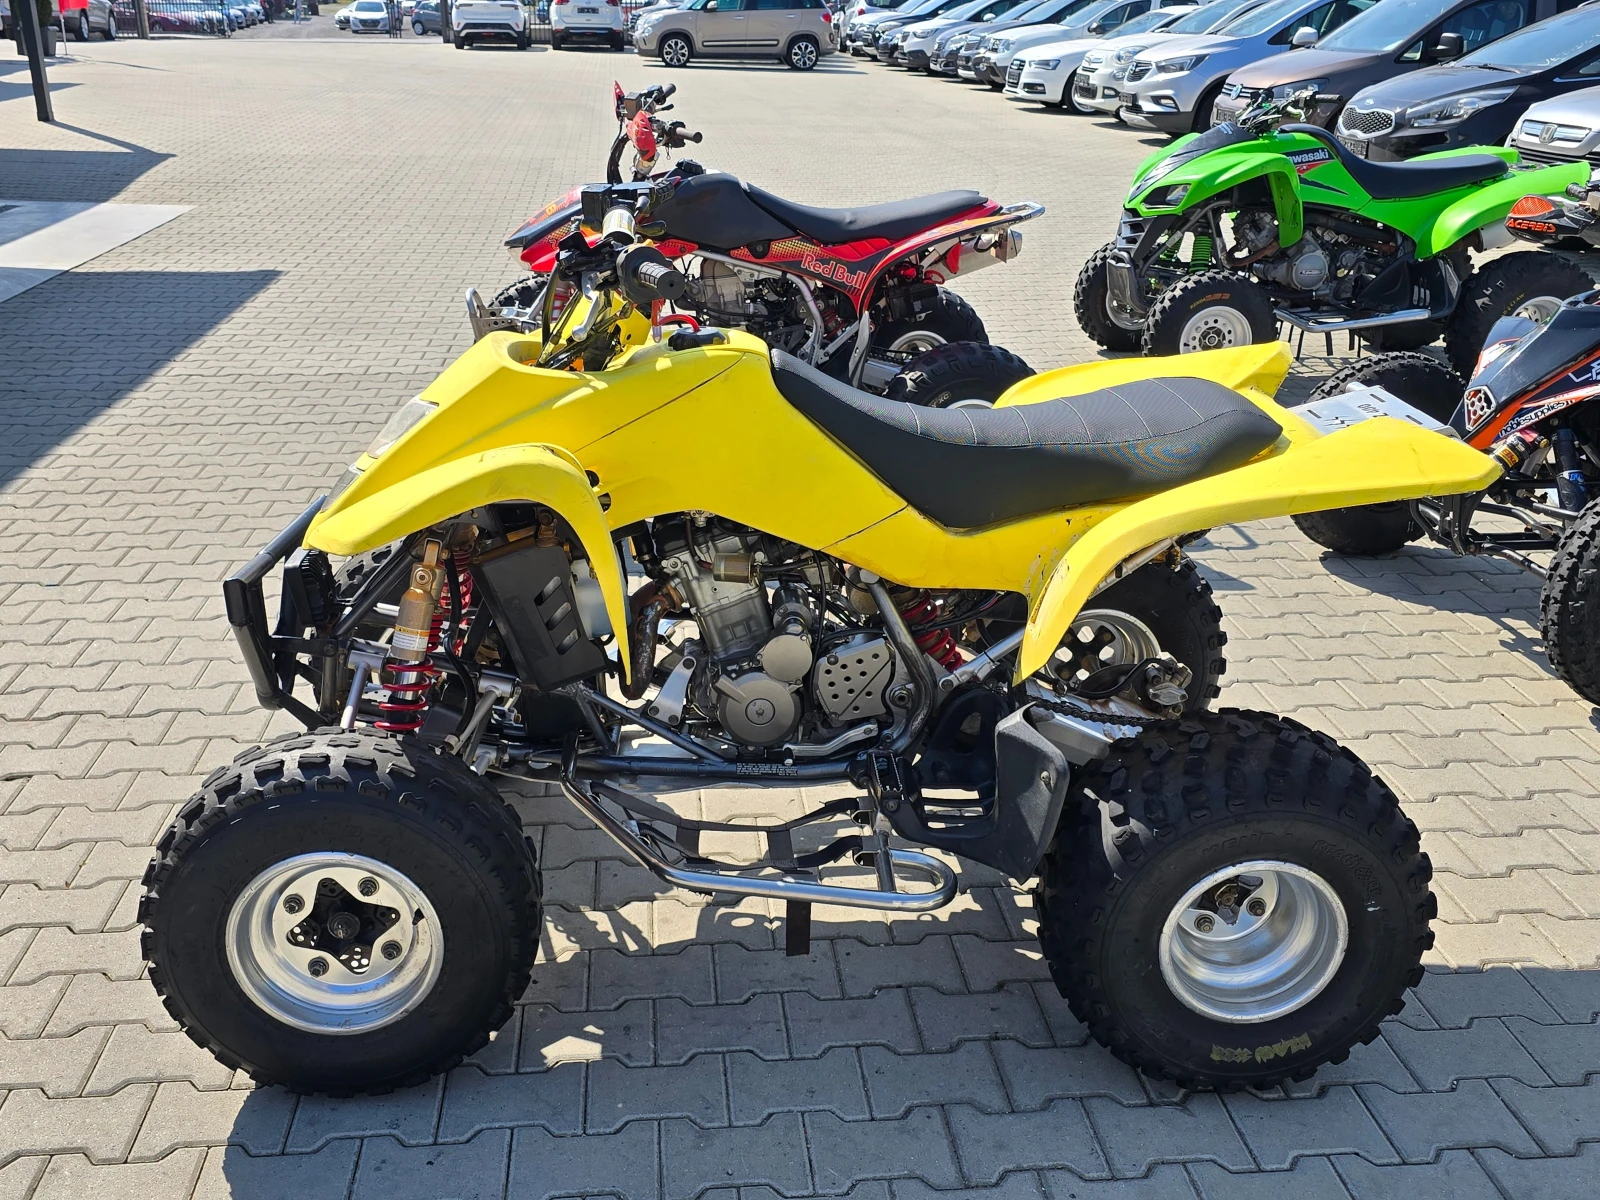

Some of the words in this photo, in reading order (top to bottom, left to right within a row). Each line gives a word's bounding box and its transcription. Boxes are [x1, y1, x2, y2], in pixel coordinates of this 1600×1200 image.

[1288, 149, 1329, 163] wasaki
[1506, 218, 1556, 233] ACERBIS
[801, 252, 836, 278] Red
[833, 263, 867, 290] Bull
